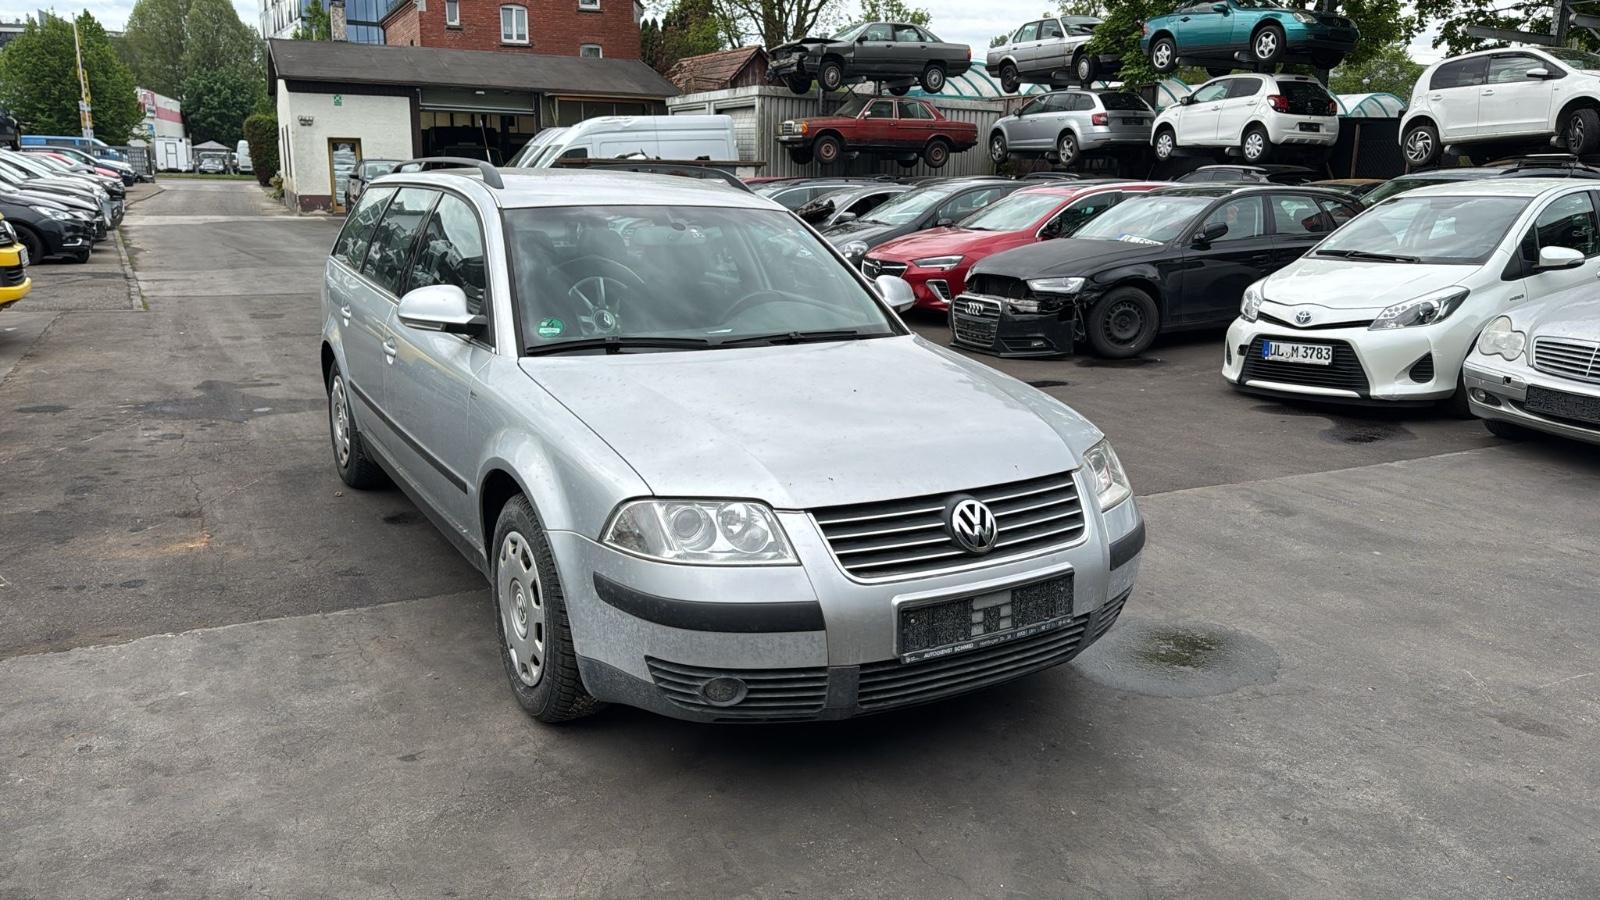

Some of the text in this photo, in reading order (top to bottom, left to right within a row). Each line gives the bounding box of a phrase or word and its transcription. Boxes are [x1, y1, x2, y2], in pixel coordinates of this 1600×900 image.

[1270, 343, 1331, 360] UL M 3783
